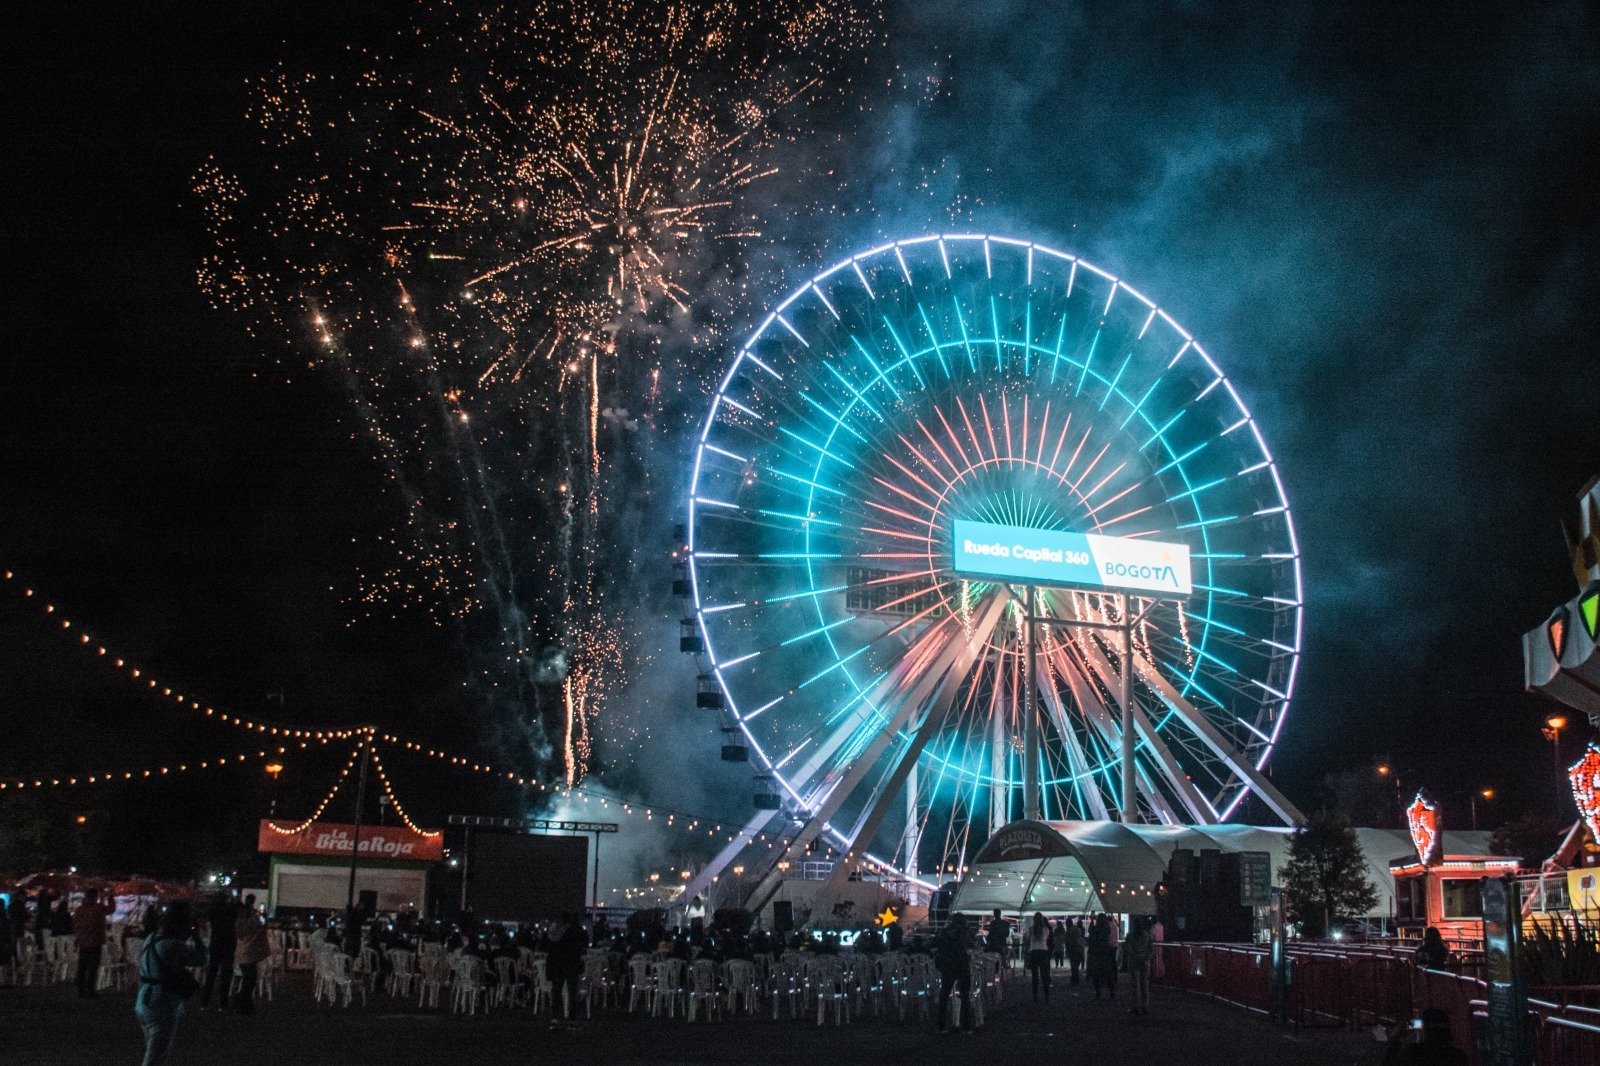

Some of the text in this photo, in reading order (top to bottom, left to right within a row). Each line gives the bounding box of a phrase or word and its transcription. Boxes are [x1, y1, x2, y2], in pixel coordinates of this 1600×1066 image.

[963, 539, 1089, 565] Rueda Capital 360
